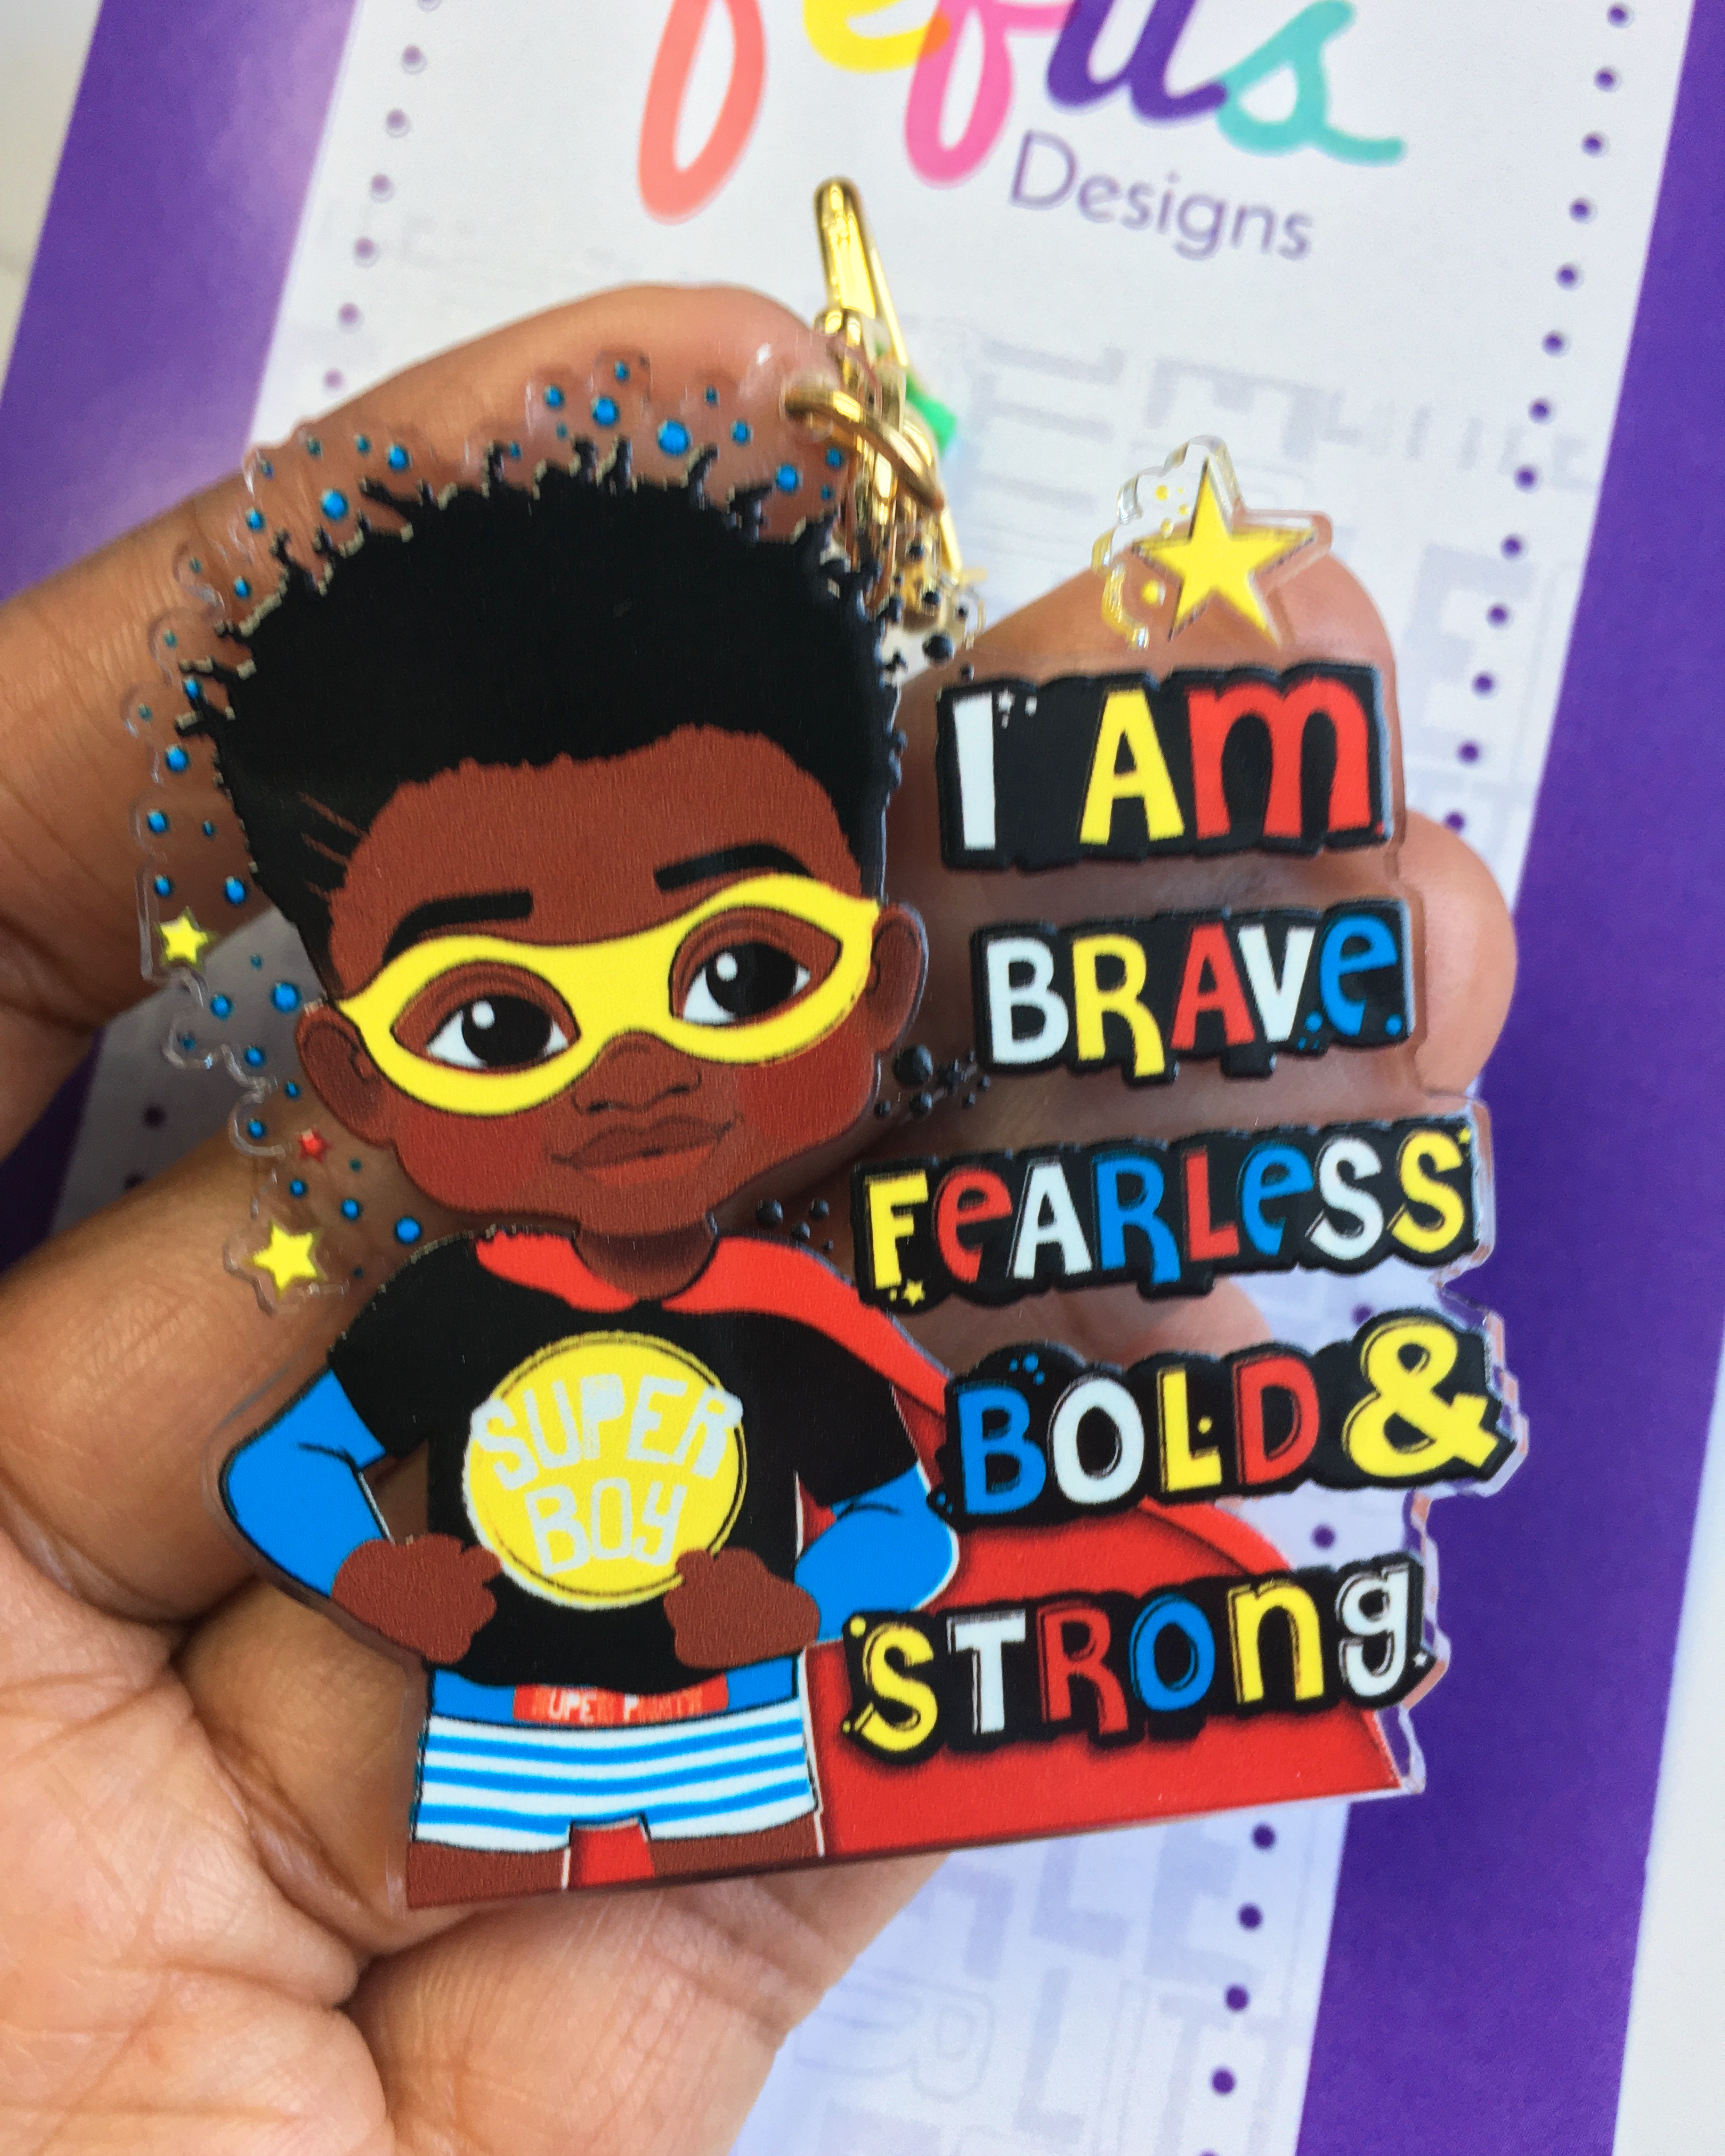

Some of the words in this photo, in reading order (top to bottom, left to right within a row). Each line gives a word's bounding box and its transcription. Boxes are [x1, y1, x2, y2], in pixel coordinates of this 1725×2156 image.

[1009, 129, 1314, 261] Designs
[953, 691, 996, 850] I
[470, 1373, 743, 1490] SUPER
[955, 1352, 1321, 1515] BOLD
[1342, 1316, 1504, 1479] &
[524, 1477, 687, 1575] BOY
